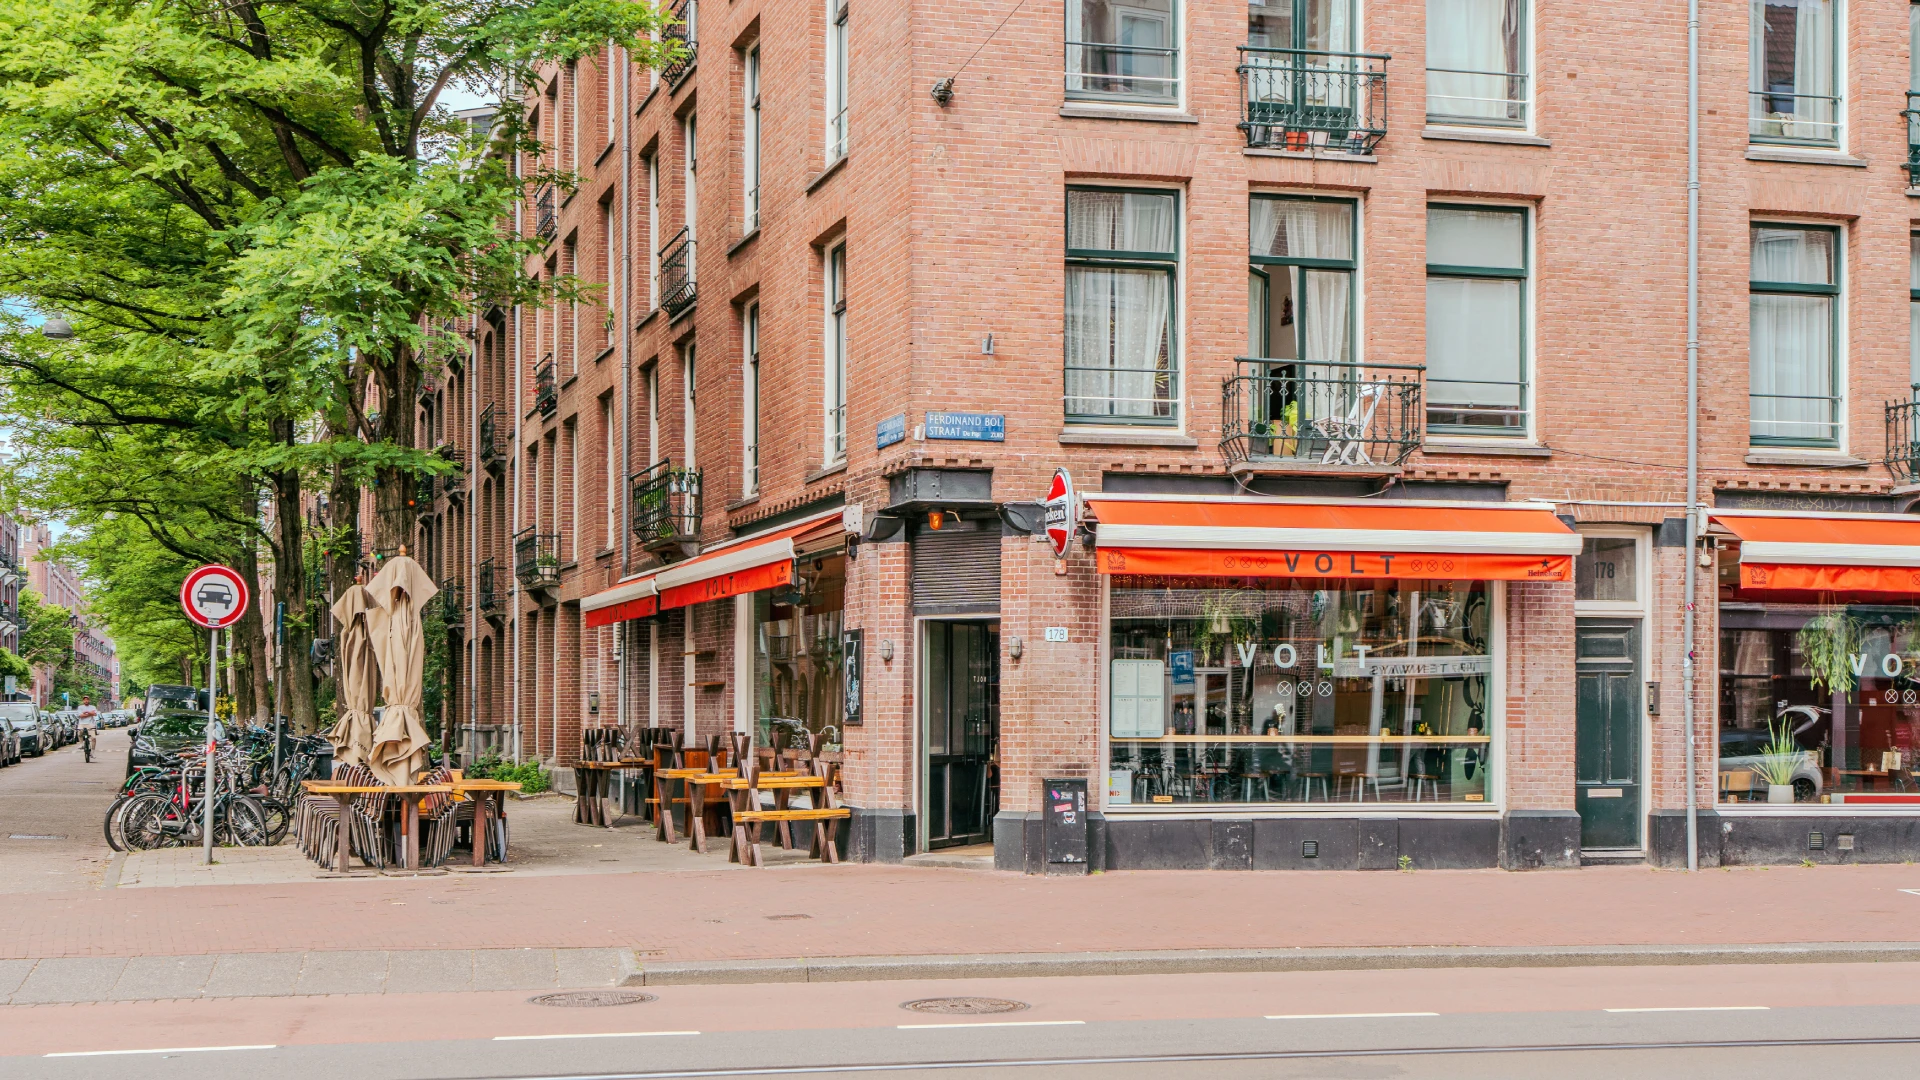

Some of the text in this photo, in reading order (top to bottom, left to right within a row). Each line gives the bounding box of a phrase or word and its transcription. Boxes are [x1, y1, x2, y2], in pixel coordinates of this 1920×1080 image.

[929, 414, 1001, 427] FERDINAND BOL
[929, 426, 961, 437] STRAAT
[1284, 553, 1395, 575] VOLT
[1527, 569, 1563, 577] Heineken
[1594, 561, 1616, 579] 178
[705, 575, 734, 598] VOLT
[1048, 629, 1065, 640] 178
[1237, 643, 1372, 669] VOLT
[1849, 653, 1903, 677] VO
